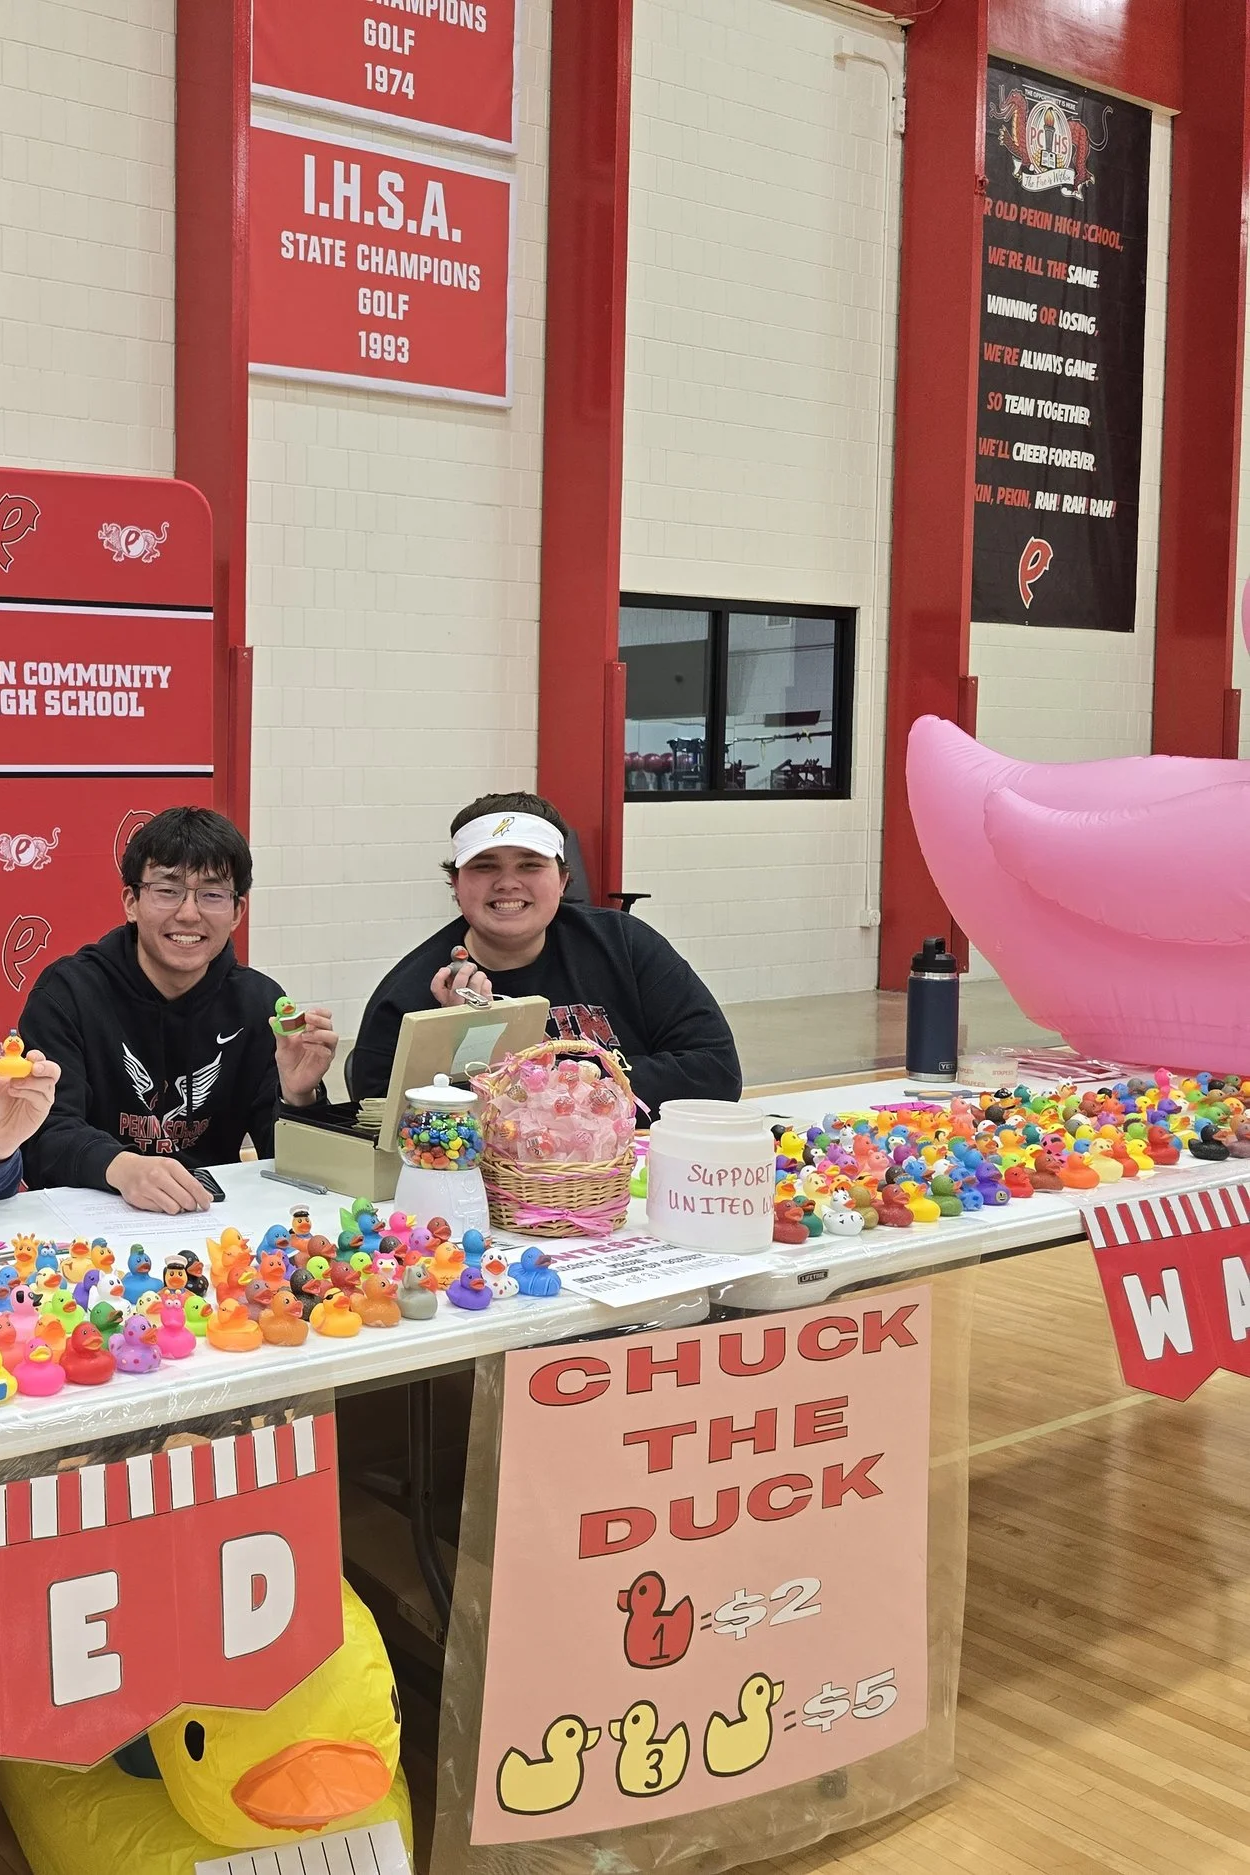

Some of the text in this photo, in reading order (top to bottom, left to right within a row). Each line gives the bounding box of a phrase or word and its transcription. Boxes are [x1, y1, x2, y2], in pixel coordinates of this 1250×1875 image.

[364, 18, 415, 55] GOLF
[364, 63, 414, 100] 1974
[304, 154, 462, 243] I.H.S.A.
[995, 200, 1018, 221] OLD
[1020, 206, 1053, 231] PEKIN
[1054, 215, 1081, 239] HIGH
[1082, 223, 1124, 252] SCHOOL,
[281, 230, 481, 292] STATE CHAMPIONS
[988, 245, 1023, 271] WE'RE
[1024, 255, 1044, 276] ALL
[1047, 260, 1067, 281] THE
[358, 287, 409, 321] GOLF
[987, 294, 1099, 336] WINNING OR LOSING,
[358, 330, 409, 364] 1993
[983, 342, 1020, 366] WE'RE
[1020, 349, 1063, 375] ALWAYS
[986, 391, 1003, 412] SO
[1004, 394, 1035, 418] TEAM
[978, 437, 1010, 459] WE'LL
[1012, 442, 1048, 464] CHEER
[997, 487, 1032, 510] PEKIN,
[1035, 491, 1061, 512] RAH!
[1062, 494, 1089, 515] RAH!
[1090, 498, 1117, 519] RAH!
[23, 661, 172, 689] COMMUNITY
[44, 690, 145, 717] SCHOOL
[119, 1112, 161, 1139] PEKIN
[687, 1163, 772, 1187] SUPPORT
[668, 1190, 754, 1216] UNITED
[528, 1303, 920, 1407] CHUCK
[623, 1395, 850, 1475] THE
[578, 1452, 885, 1560] DUCK
[644, 1748, 665, 1789] 3
